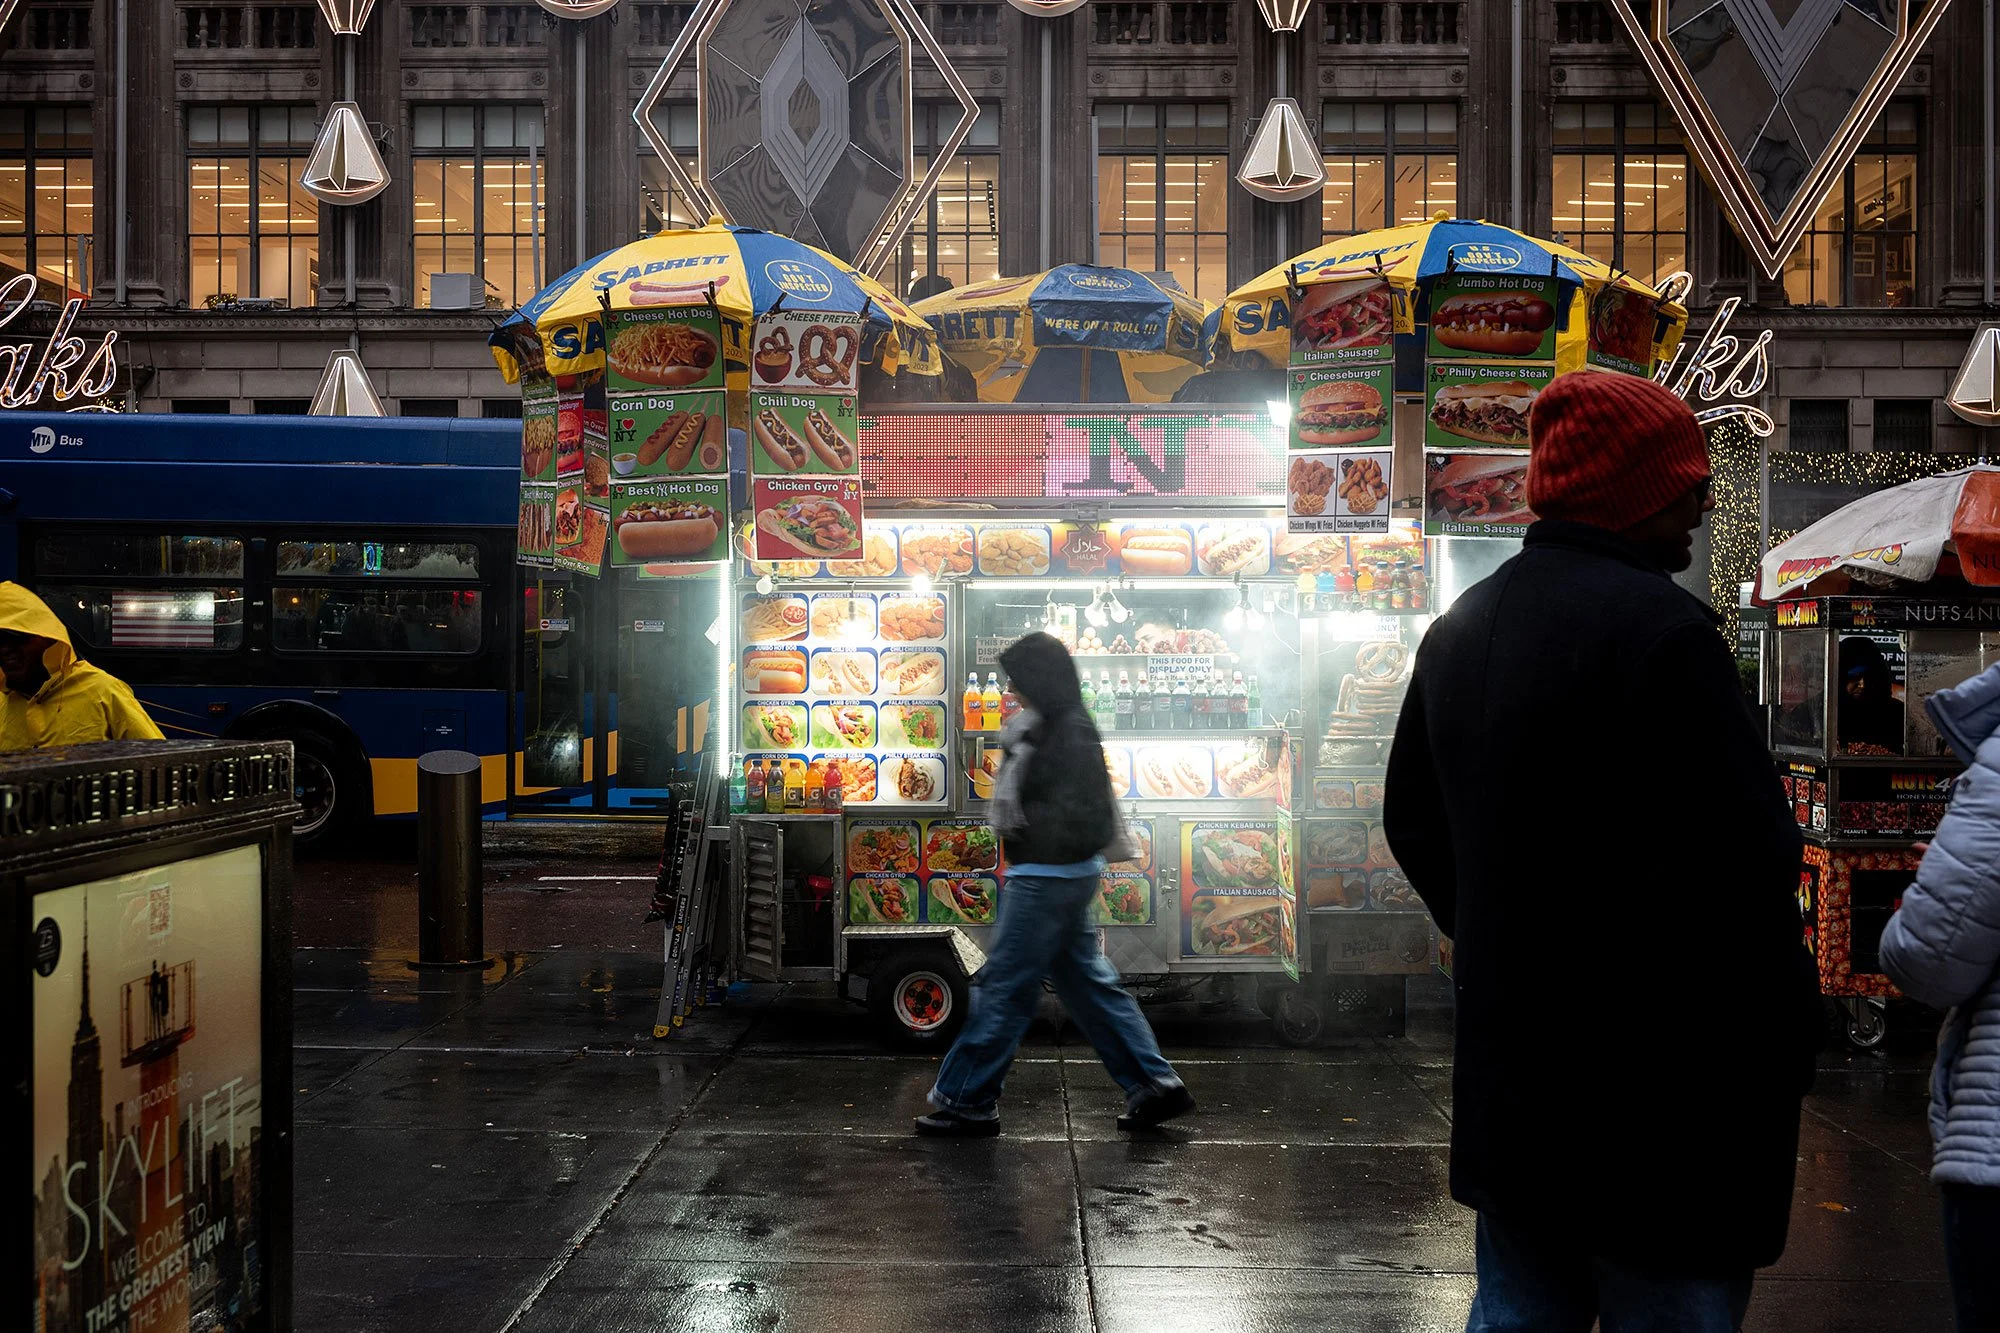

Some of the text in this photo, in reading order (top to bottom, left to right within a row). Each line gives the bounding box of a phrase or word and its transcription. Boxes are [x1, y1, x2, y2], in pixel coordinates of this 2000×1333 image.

[1290, 240, 1419, 275] SABRETT
[1459, 257, 1516, 265] INSPECTED
[591, 255, 729, 290] SABRETT
[778, 281, 829, 292] INSPECTED
[1457, 277, 1545, 291] Jumbo Hot Dog
[623, 307, 713, 323] Cheese Hot Dog
[759, 316, 777, 324] NY
[784, 312, 862, 325] CHEESE PRETZEL
[1045, 317, 1080, 330] WE'RE
[1083, 320, 1100, 331] ON
[1101, 322, 1109, 332] A
[1113, 321, 1140, 333] ROLL
[0, 273, 118, 408] aks
[1304, 347, 1380, 361] Italian Sausage
[912, 363, 929, 371] 2023
[1595, 353, 1641, 373] Chicken Over Rice
[1310, 369, 1382, 382] Cheeseburger
[1430, 374, 1446, 383] NY
[1449, 367, 1548, 380] Philly Cheese Steak
[1291, 383, 1305, 391] NY
[611, 398, 674, 412] Corn Dog
[758, 396, 816, 410] Chili Dog
[837, 407, 853, 418] NY
[31, 430, 83, 447] MTA Bus
[614, 429, 637, 443] NY
[584, 437, 609, 451] andwic
[628, 485, 655, 497] Best
[669, 483, 692, 494] Hot
[695, 482, 719, 495] Dog
[767, 480, 839, 493] Chicken Gyro
[843, 490, 859, 500] NY
[1289, 518, 1333, 530] Chicken Wings Fries
[1337, 518, 1388, 530] Chicken Nuggets Fries
[1441, 523, 1527, 536] Italian Sausag
[1071, 537, 1102, 553] حلال
[1076, 553, 1098, 562] HALAL
[562, 557, 577, 568] Over
[576, 561, 590, 572] Rice
[1853, 614, 1876, 626] NUTS
[1740, 629, 1752, 642] NEW
[978, 639, 1021, 647] THIS FOO
[1151, 657, 1210, 665] THIS FOOD FOR
[1150, 666, 1212, 674] DISPLAY ONLY
[0, 752, 292, 837] ROCKEFELLER CENTER
[1198, 822, 1266, 830] CHICKEN KEBAB ON
[1213, 889, 1278, 897] ITALIAN SAUSAGE
[127, 1072, 193, 1117] INTRODUCING
[62, 1076, 243, 1271] SKYLIFT
[112, 1202, 208, 1282] WELCOME TO
[86, 1216, 227, 1333] THE GREATEST VIEW
[130, 1261, 210, 1333] THE WORLD
